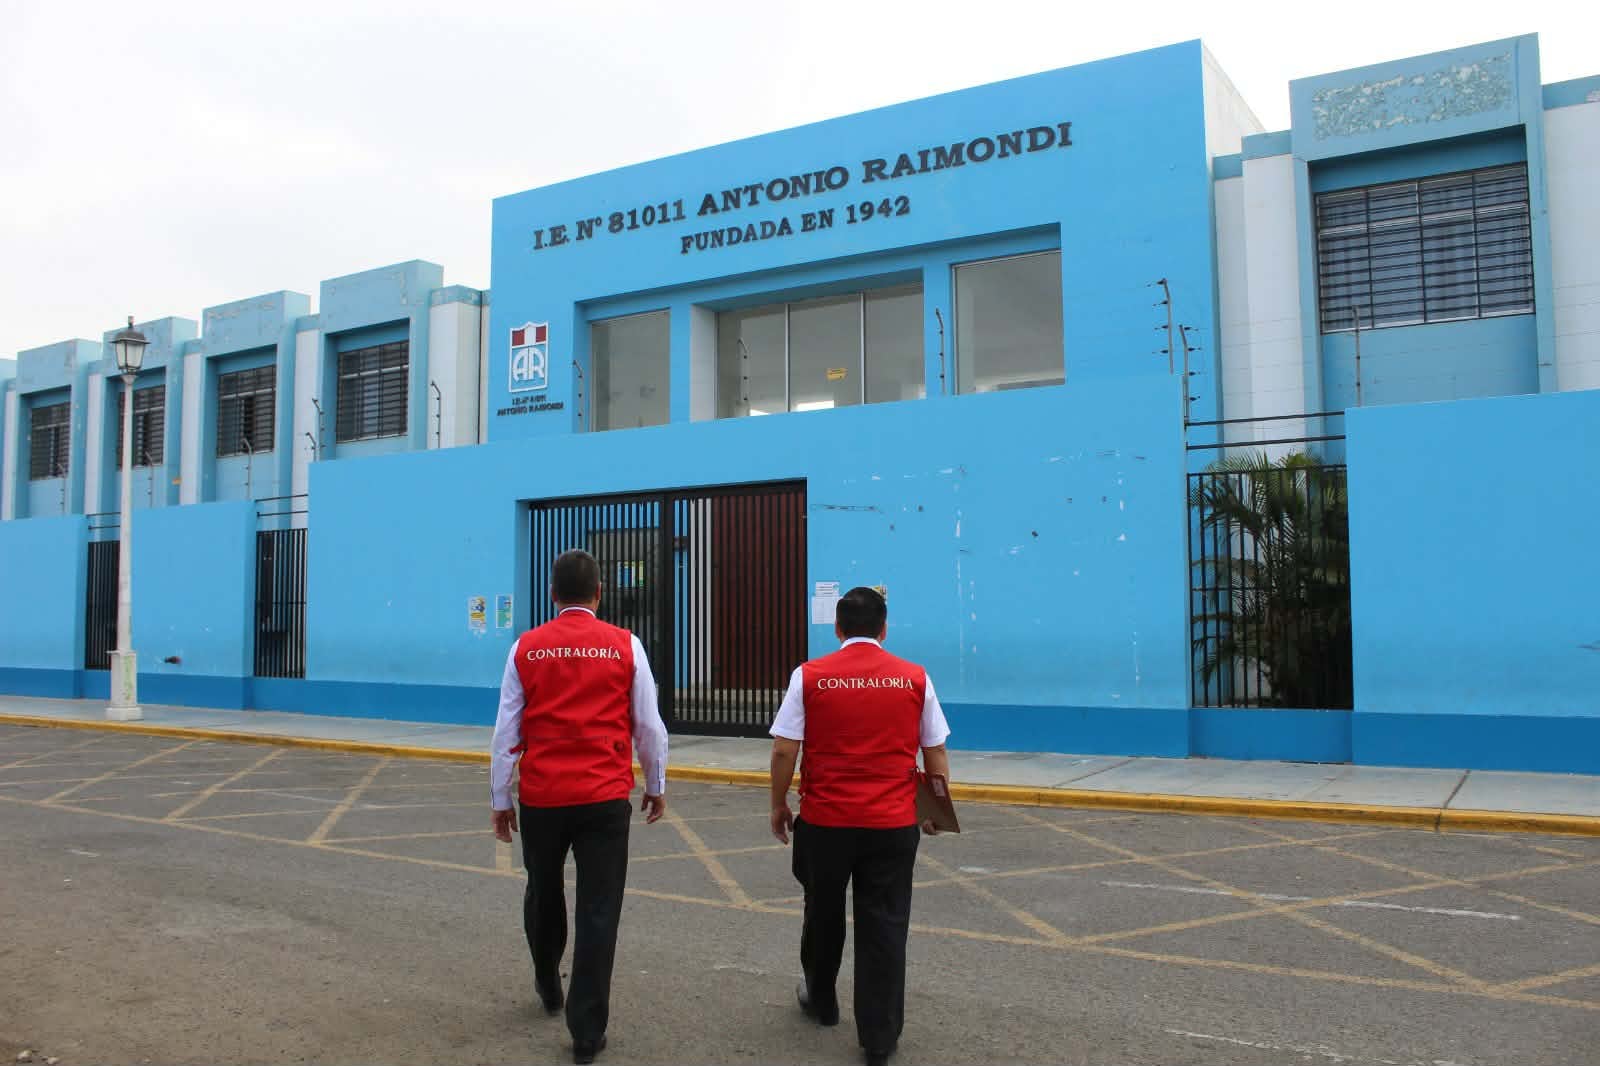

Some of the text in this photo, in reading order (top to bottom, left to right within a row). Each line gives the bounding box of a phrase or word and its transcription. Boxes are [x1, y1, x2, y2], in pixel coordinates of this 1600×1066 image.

[608, 198, 687, 234] 81011
[697, 166, 849, 216] ANTONIO
[862, 122, 1073, 183] RAIMONDI
[680, 195, 911, 254] FUNDADA EN 1942
[527, 646, 621, 661] CONTRALORÍA
[817, 676, 914, 690] CONTRALORÍA
